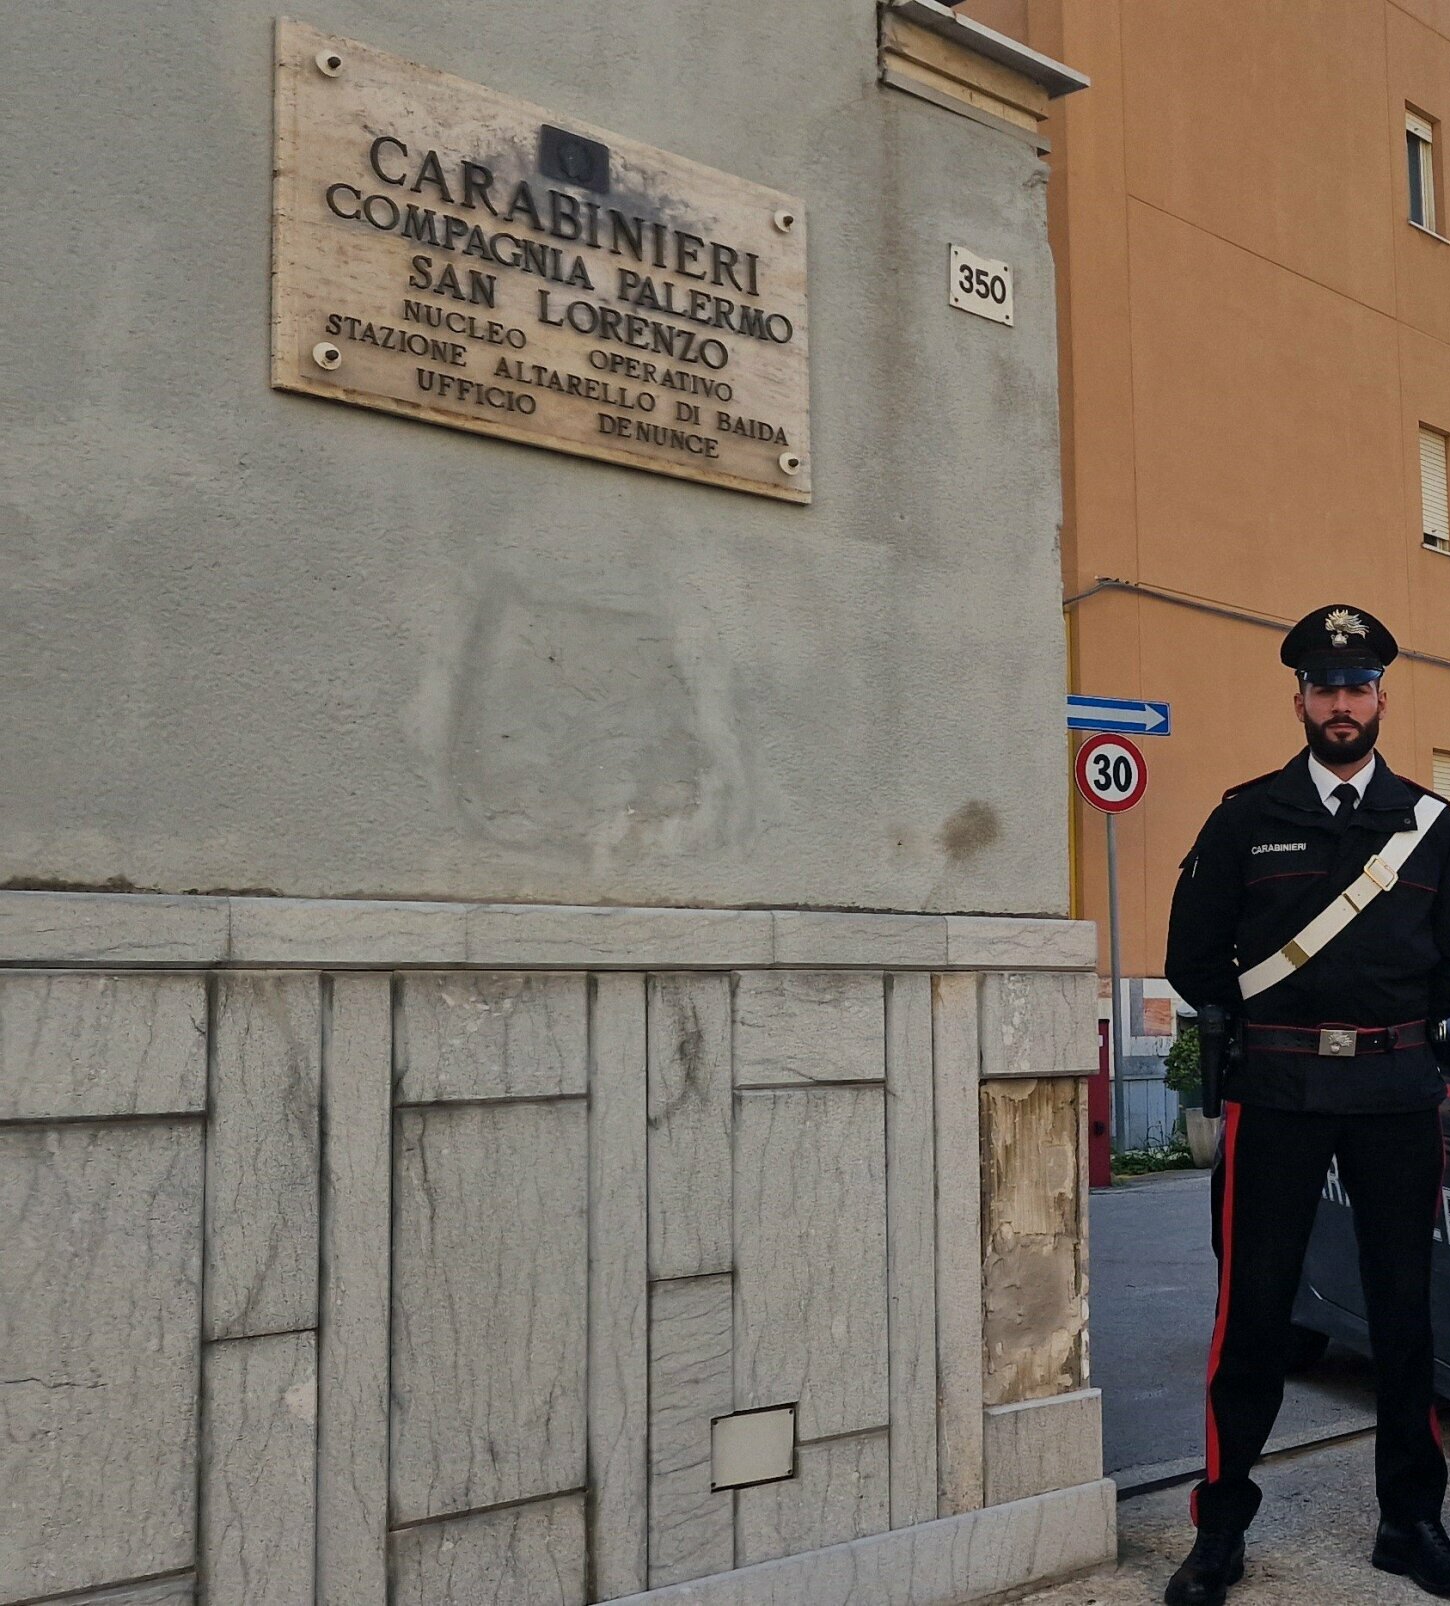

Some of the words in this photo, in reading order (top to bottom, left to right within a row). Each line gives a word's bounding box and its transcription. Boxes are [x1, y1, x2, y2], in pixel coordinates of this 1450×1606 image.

[326, 183, 594, 290] COMPAGNIA
[618, 268, 793, 344] PALERMO
[369, 136, 760, 296] CARABINIERI
[409, 255, 496, 308] SAN
[537, 289, 729, 369] LORENZO
[959, 263, 1006, 304] 350
[326, 314, 467, 367] STAZIONE
[494, 357, 656, 413] ALTARELLO
[675, 403, 701, 426] DI
[717, 411, 789, 446] BAIDA
[403, 300, 527, 349] NUCLEO
[589, 349, 733, 402] OPERATIVO
[416, 368, 536, 415] UFFICIO
[598, 412, 719, 459] DENUNCE
[1093, 754, 1132, 792] 30
[1251, 843, 1306, 855] CARABINIERI
